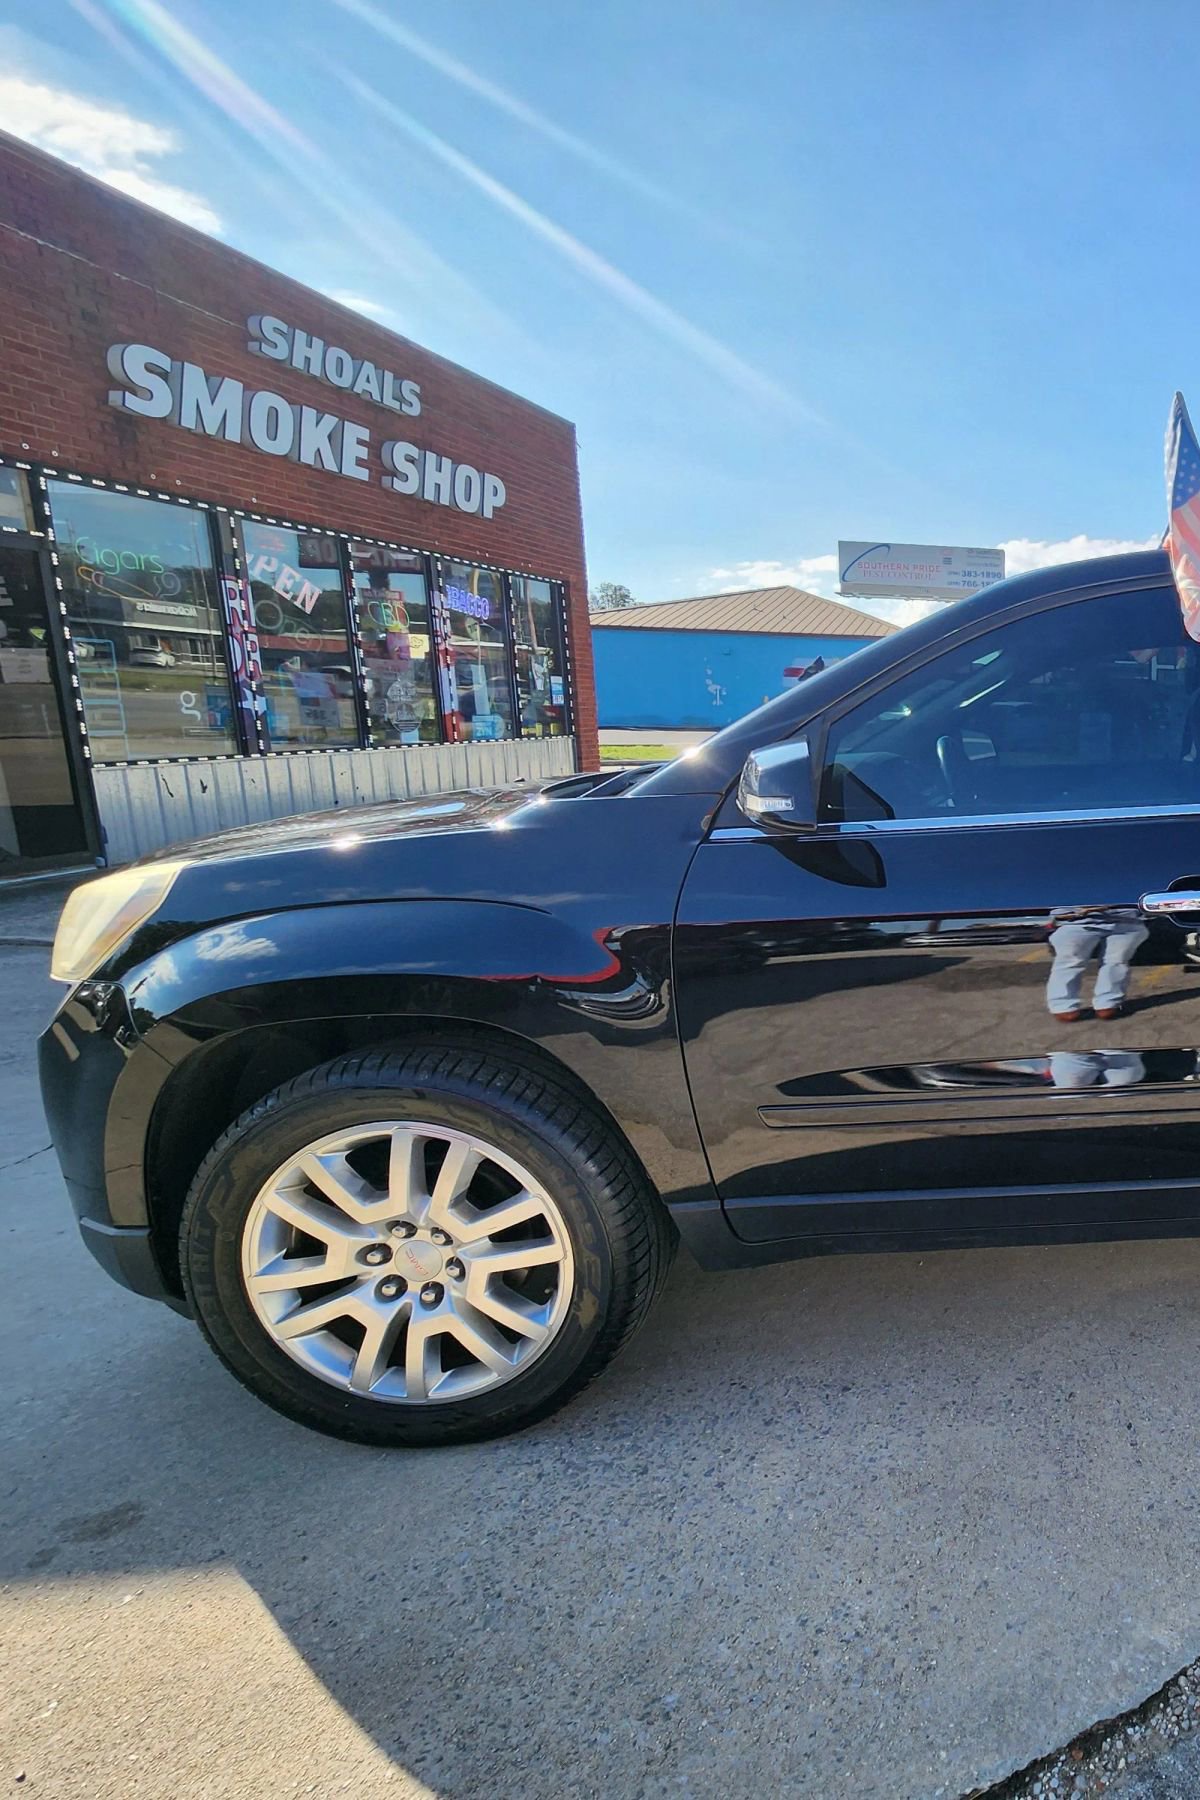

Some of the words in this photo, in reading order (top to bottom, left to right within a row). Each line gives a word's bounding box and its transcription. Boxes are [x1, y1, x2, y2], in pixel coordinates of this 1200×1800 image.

[248, 315, 423, 417] SHOALS
[108, 344, 371, 482] SMOKE
[381, 440, 507, 519] SHOP
[75, 536, 165, 575] Cigars
[857, 561, 909, 571] SOUTHERN
[912, 564, 941, 573] PRIDE
[247, 552, 323, 616] PEN
[368, 601, 409, 628] CBD
